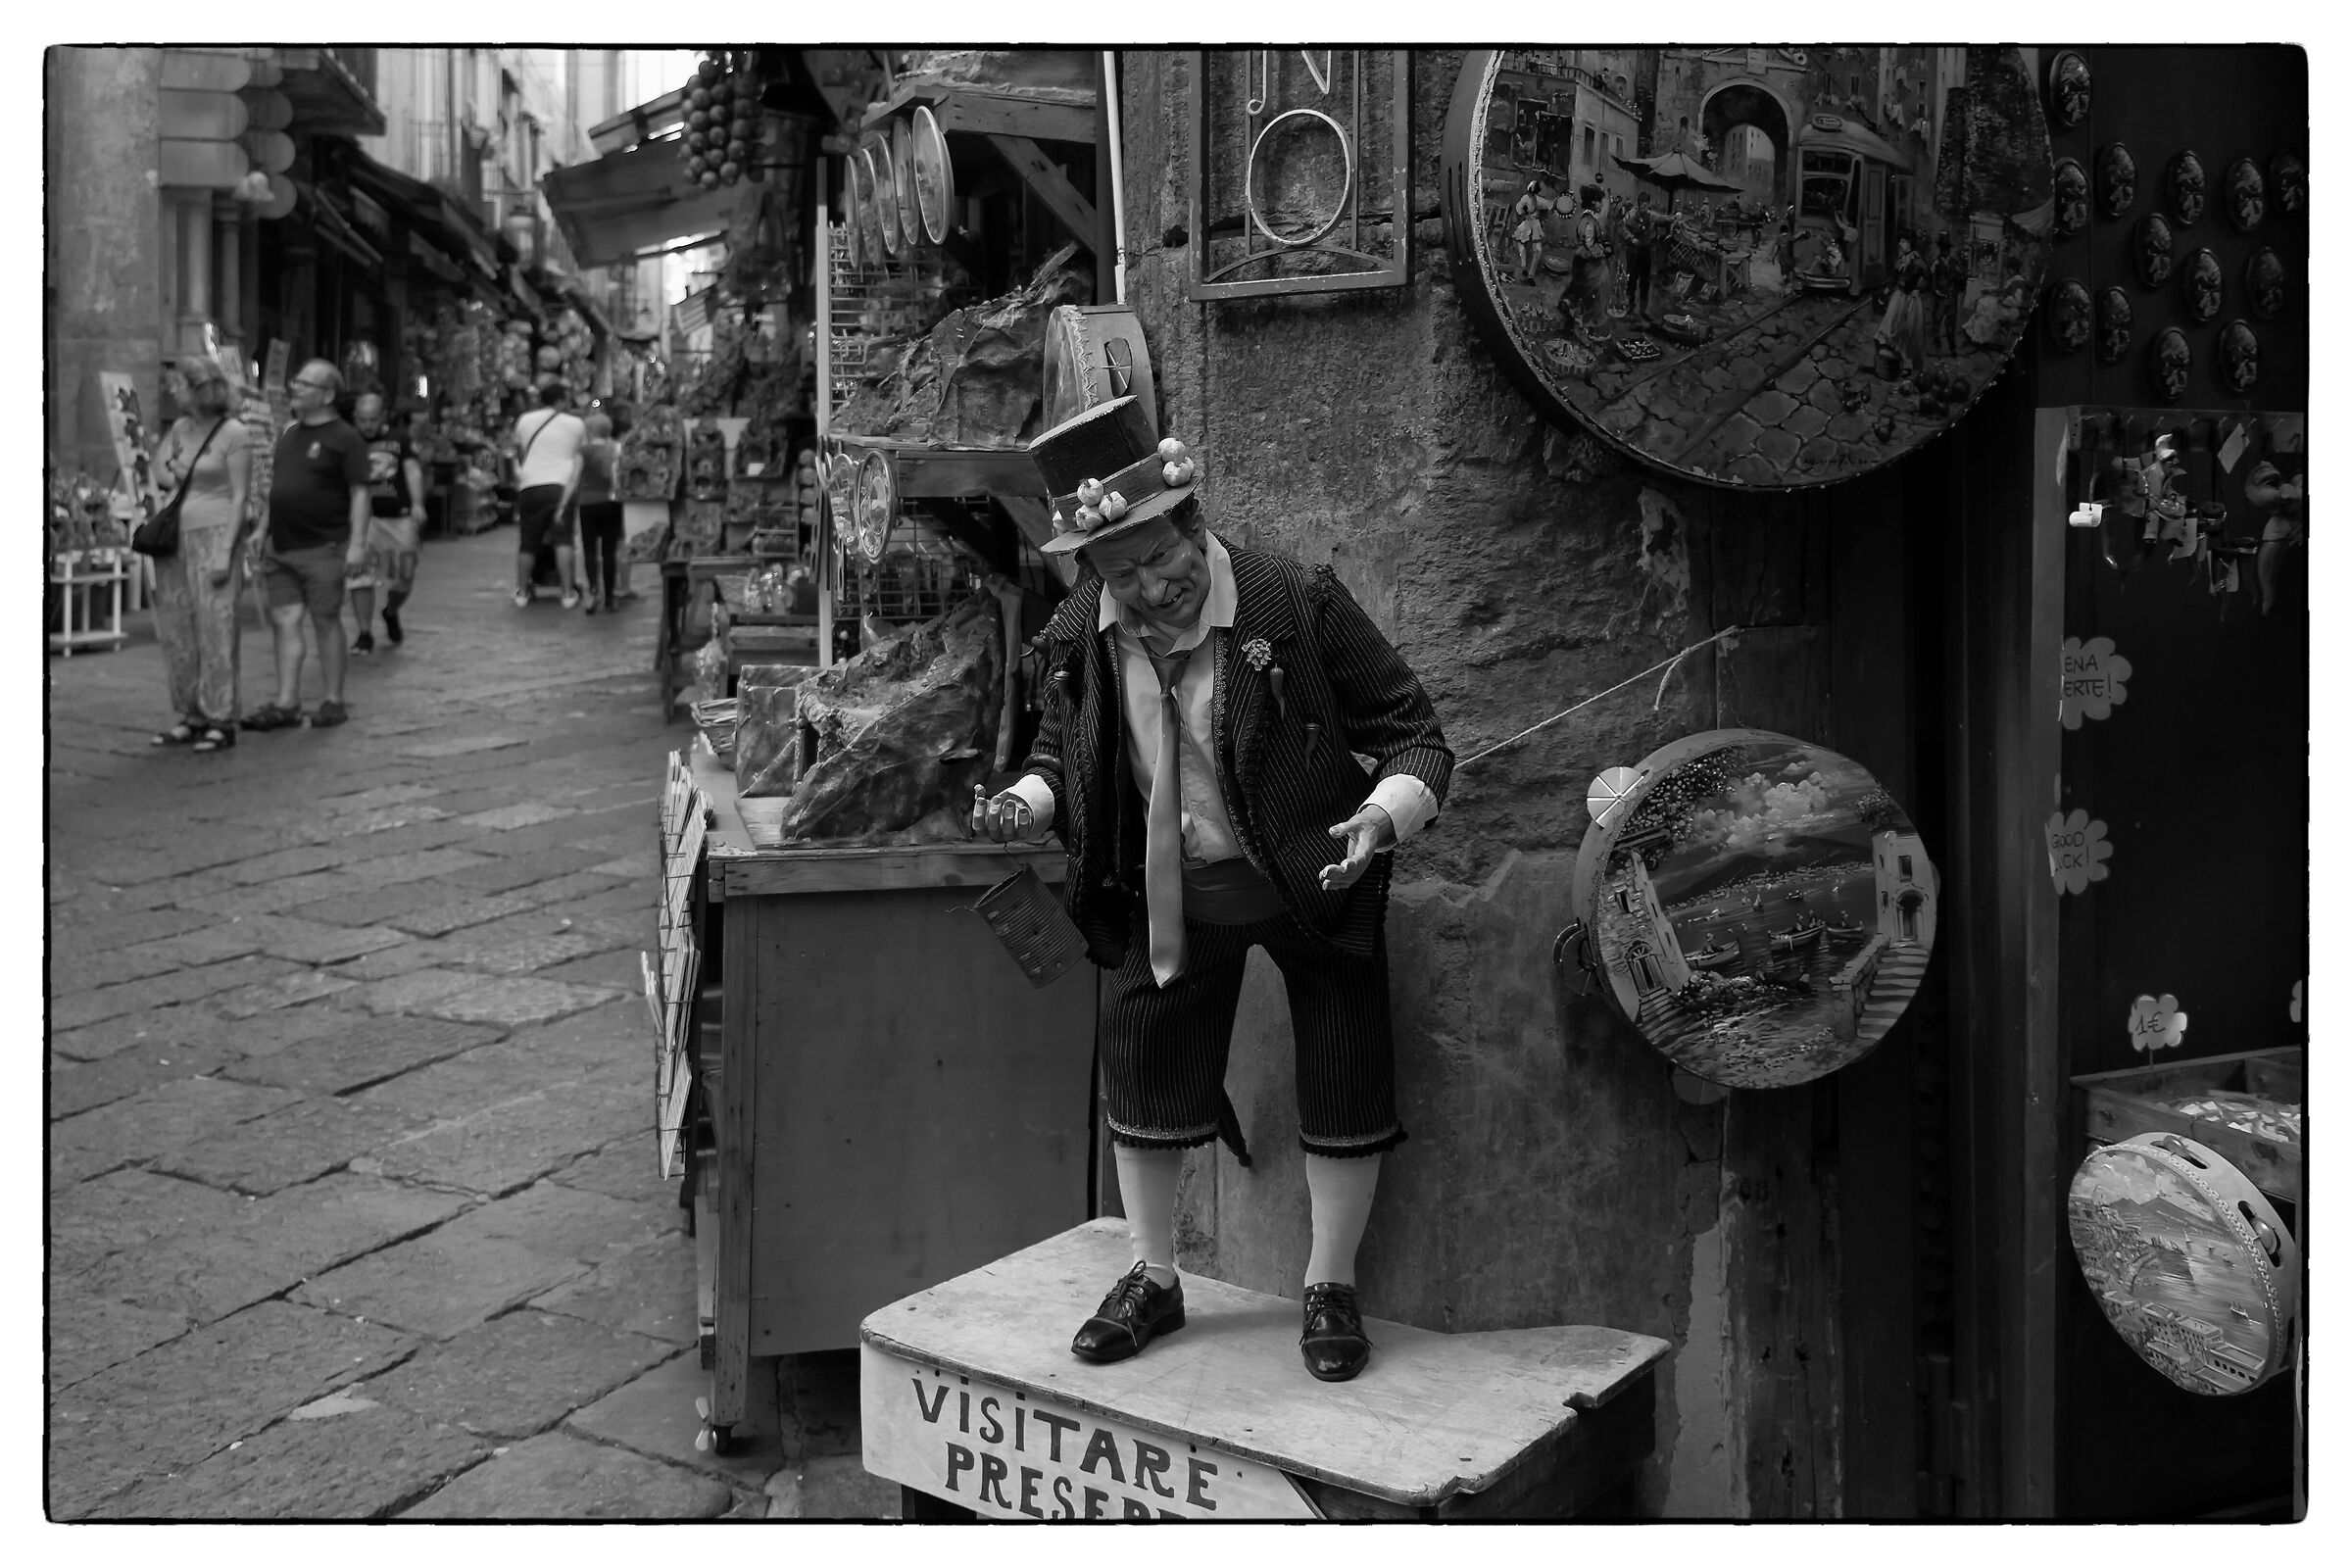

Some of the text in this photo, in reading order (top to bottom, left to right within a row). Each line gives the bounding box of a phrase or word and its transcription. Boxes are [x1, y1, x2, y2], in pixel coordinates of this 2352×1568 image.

[2064, 654, 2098, 674] ENA
[2064, 671, 2111, 699] ERTE!
[2051, 831, 2085, 849] GOOD
[2134, 1011, 2166, 1036] 1€
